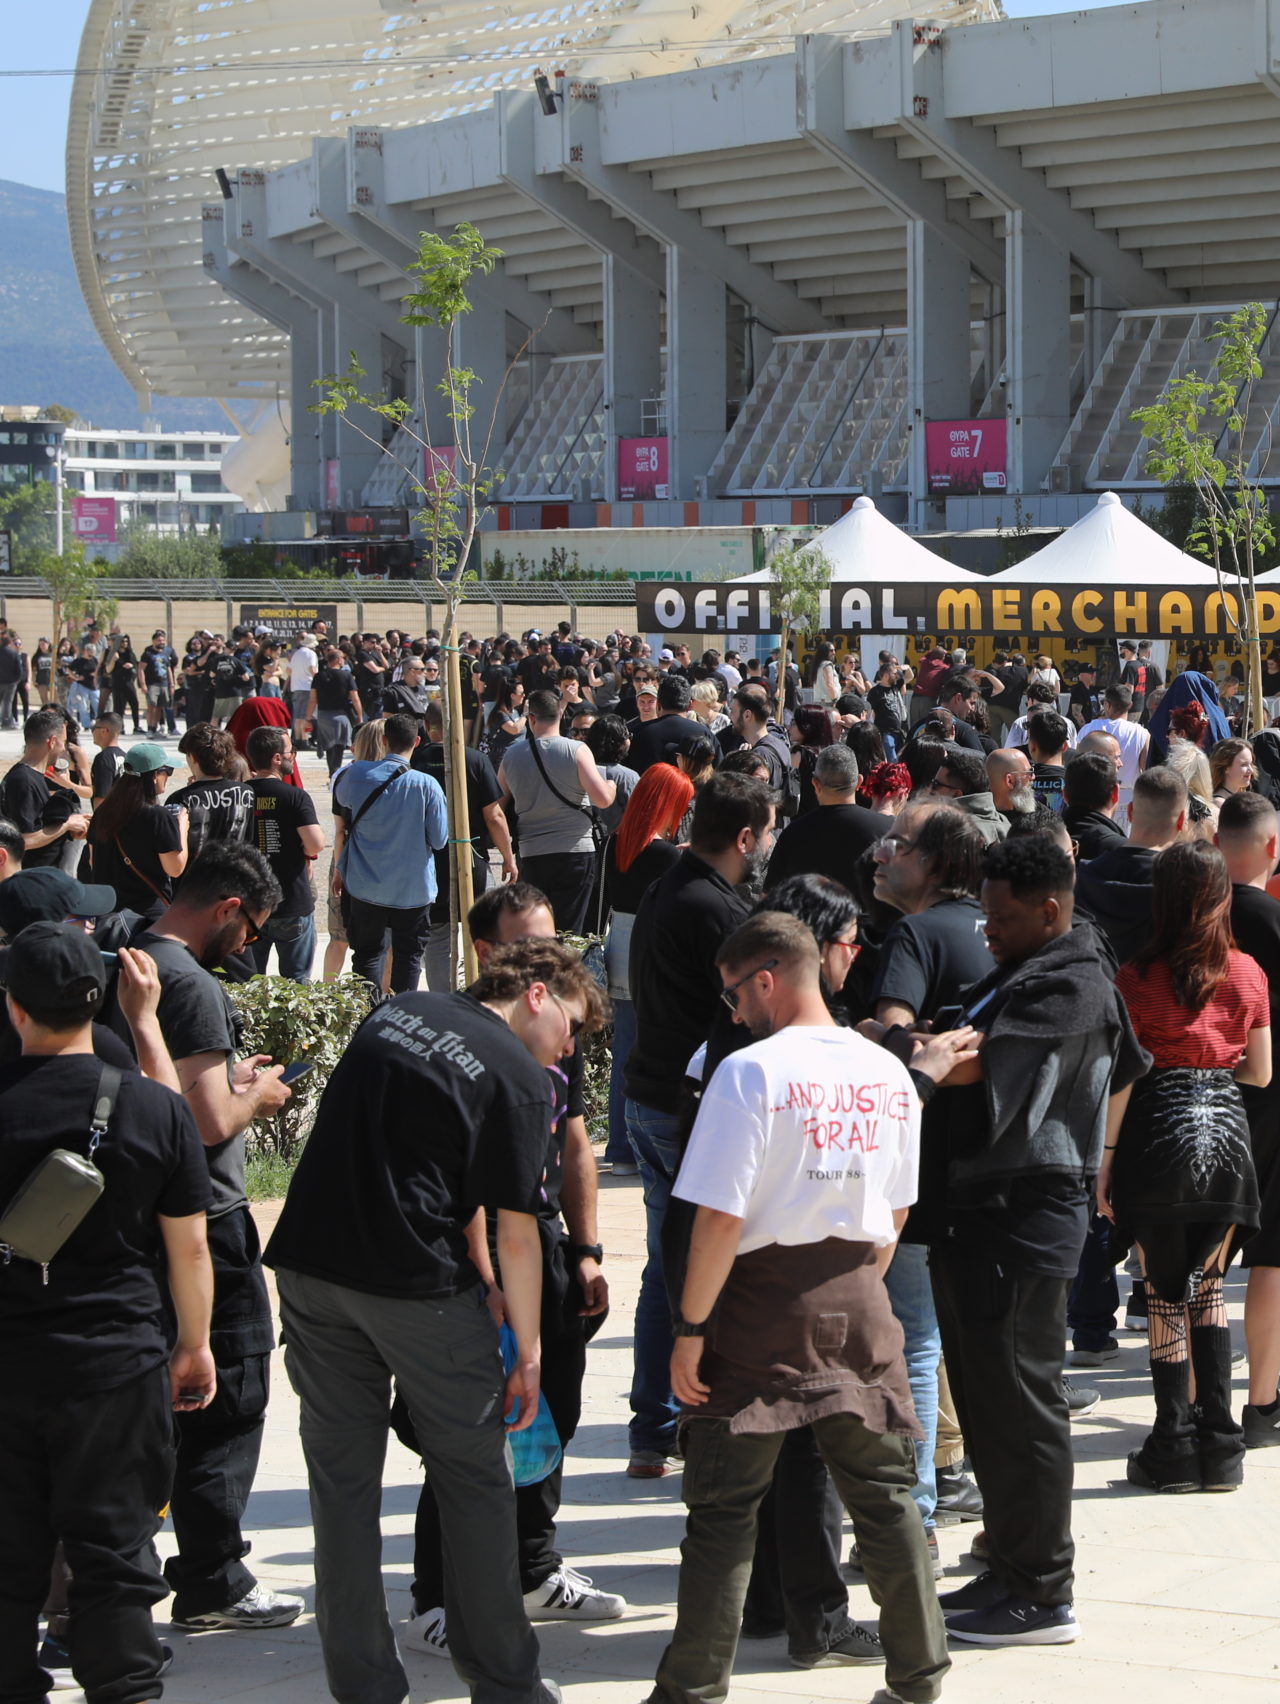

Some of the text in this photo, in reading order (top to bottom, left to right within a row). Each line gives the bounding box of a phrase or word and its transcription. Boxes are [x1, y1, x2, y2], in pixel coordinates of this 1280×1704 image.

[950, 430, 970, 442] ΘΥΡΑ
[971, 430, 982, 458] 7
[650, 446, 658, 472] 8
[950, 447, 970, 458] GATE
[636, 462, 650, 472] GATE
[298, 610, 318, 618] GATES
[202, 786, 254, 810] JUSTICE
[418, 1027, 438, 1040] on
[432, 1030, 486, 1081] Titan
[828, 1083, 910, 1120] JUSTICE
[803, 1116, 880, 1153] FOR ALL
[806, 1170, 843, 1180] TOUR
